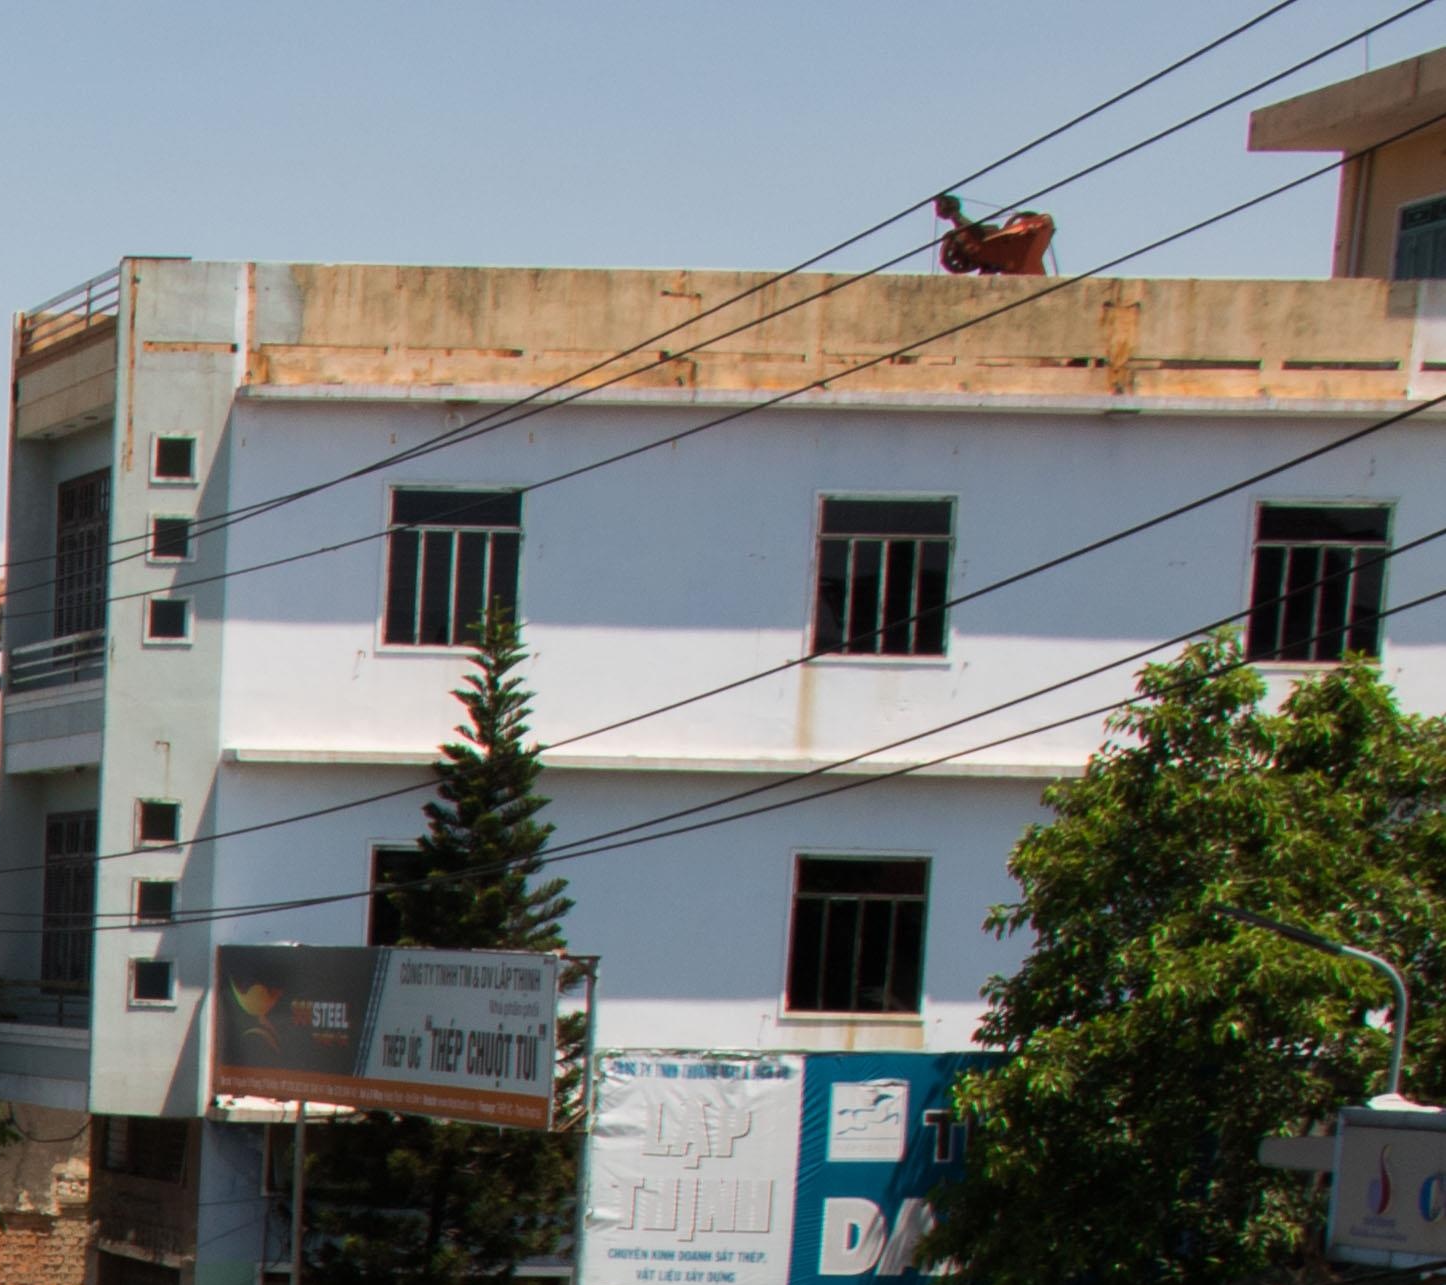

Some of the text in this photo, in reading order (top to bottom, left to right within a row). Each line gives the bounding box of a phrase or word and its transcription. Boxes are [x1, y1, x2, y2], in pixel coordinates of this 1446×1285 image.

[400, 958, 423, 985] CÔNG
[383, 1028, 405, 1068] THÉP
[467, 1023, 512, 1088] CHUỘT
